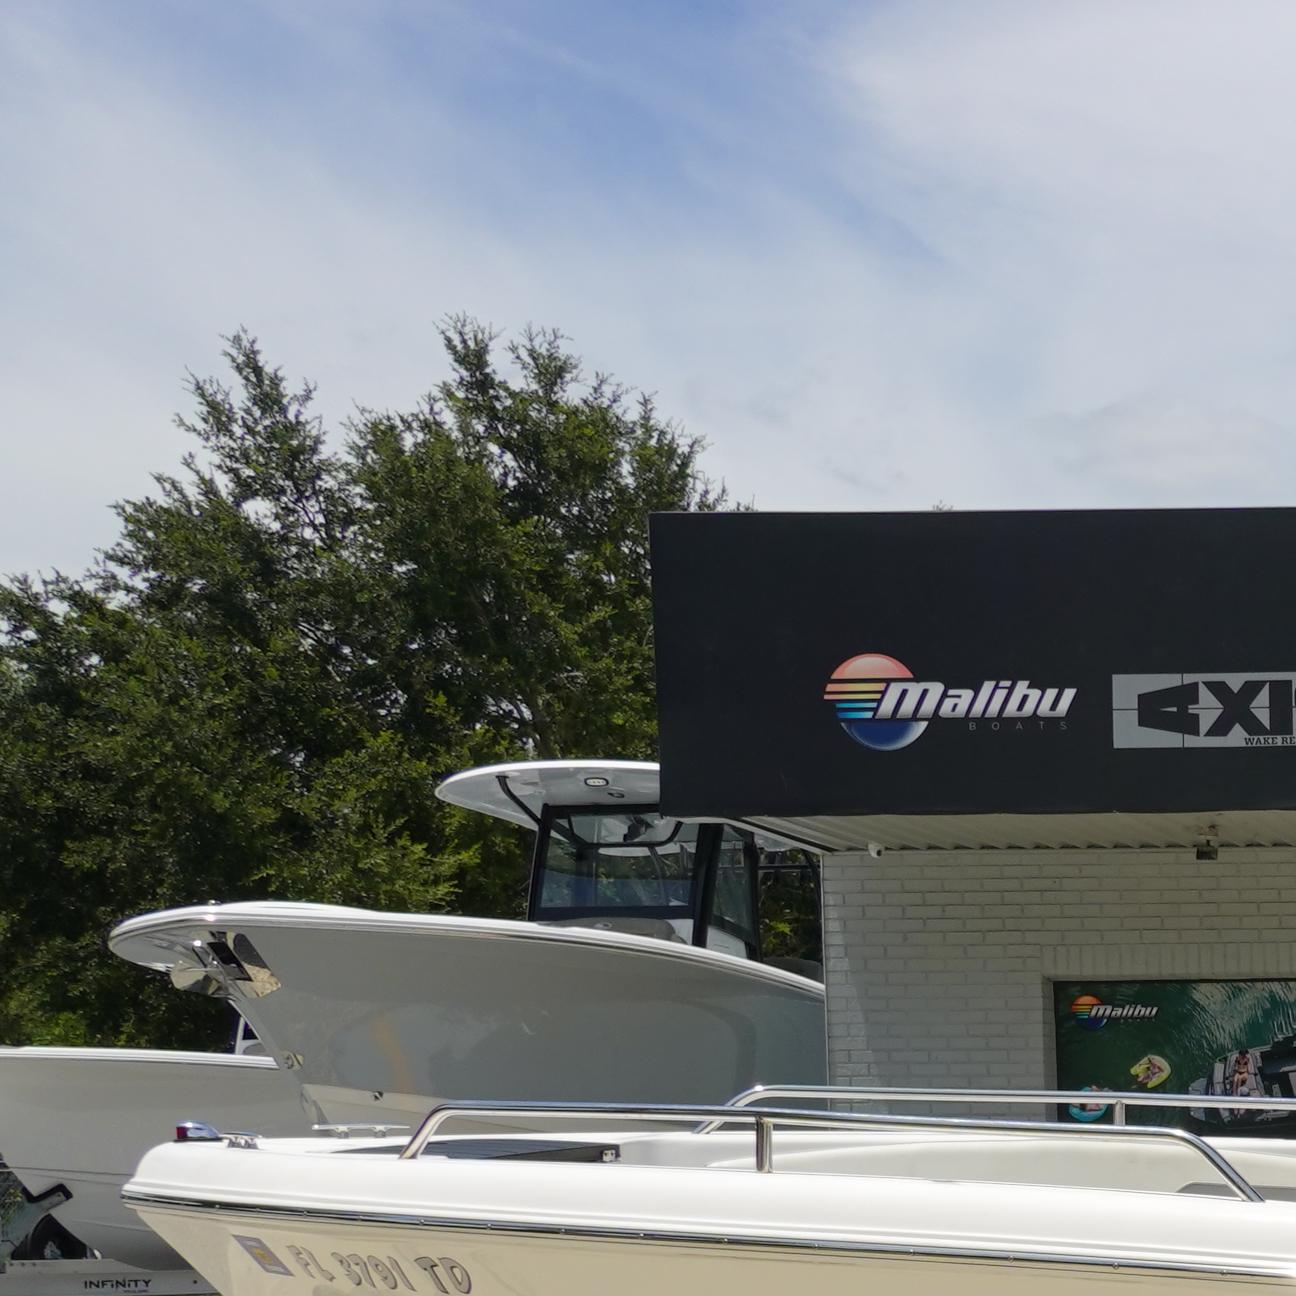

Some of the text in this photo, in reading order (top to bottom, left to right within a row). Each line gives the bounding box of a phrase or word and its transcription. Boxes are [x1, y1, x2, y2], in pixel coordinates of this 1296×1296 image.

[874, 680, 1078, 719] Malibu
[968, 721, 1068, 731] BOATS
[1244, 736, 1278, 745] WAKE
[1090, 1004, 1159, 1018] Malibu
[414, 1256, 472, 1295] TD
